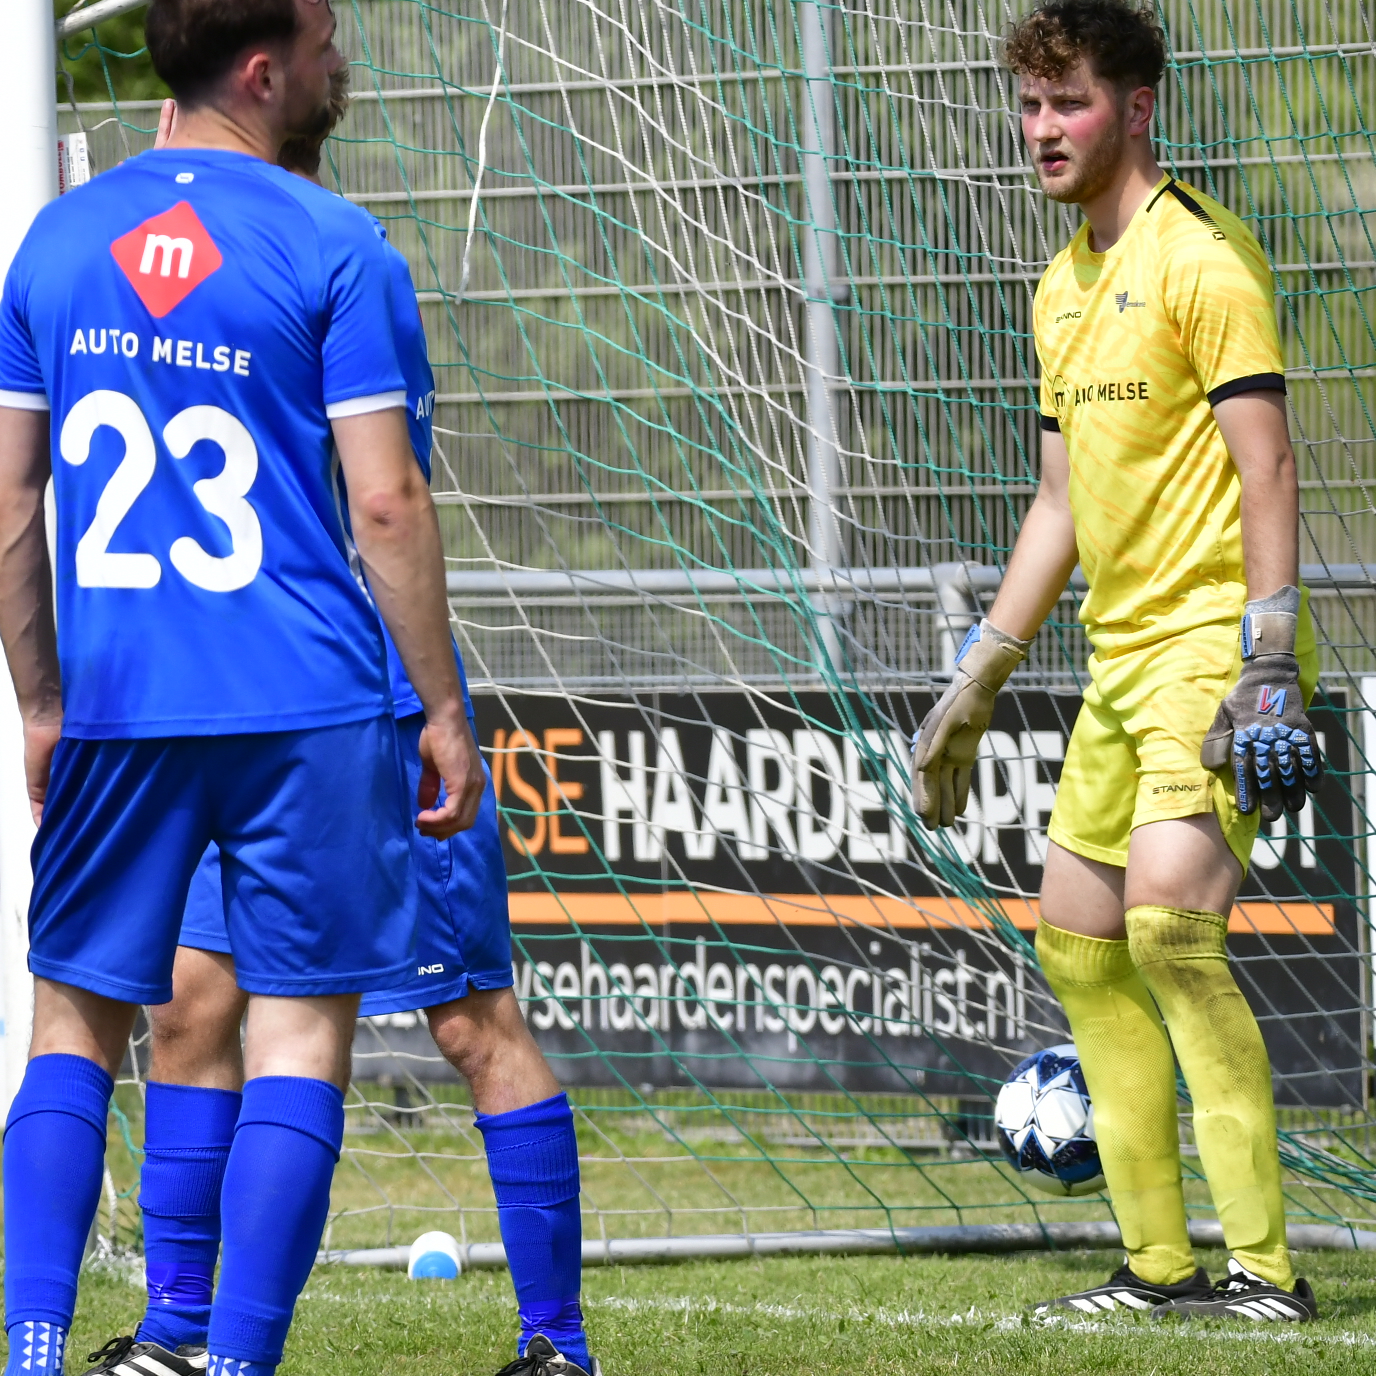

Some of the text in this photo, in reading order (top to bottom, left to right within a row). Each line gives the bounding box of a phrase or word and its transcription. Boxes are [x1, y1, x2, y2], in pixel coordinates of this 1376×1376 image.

[139, 233, 194, 279] m
[69, 328, 252, 377] AUTO MELSE
[1097, 382, 1150, 402] MELSE
[60, 390, 262, 592] 23
[1152, 784, 1203, 795] STANNO
